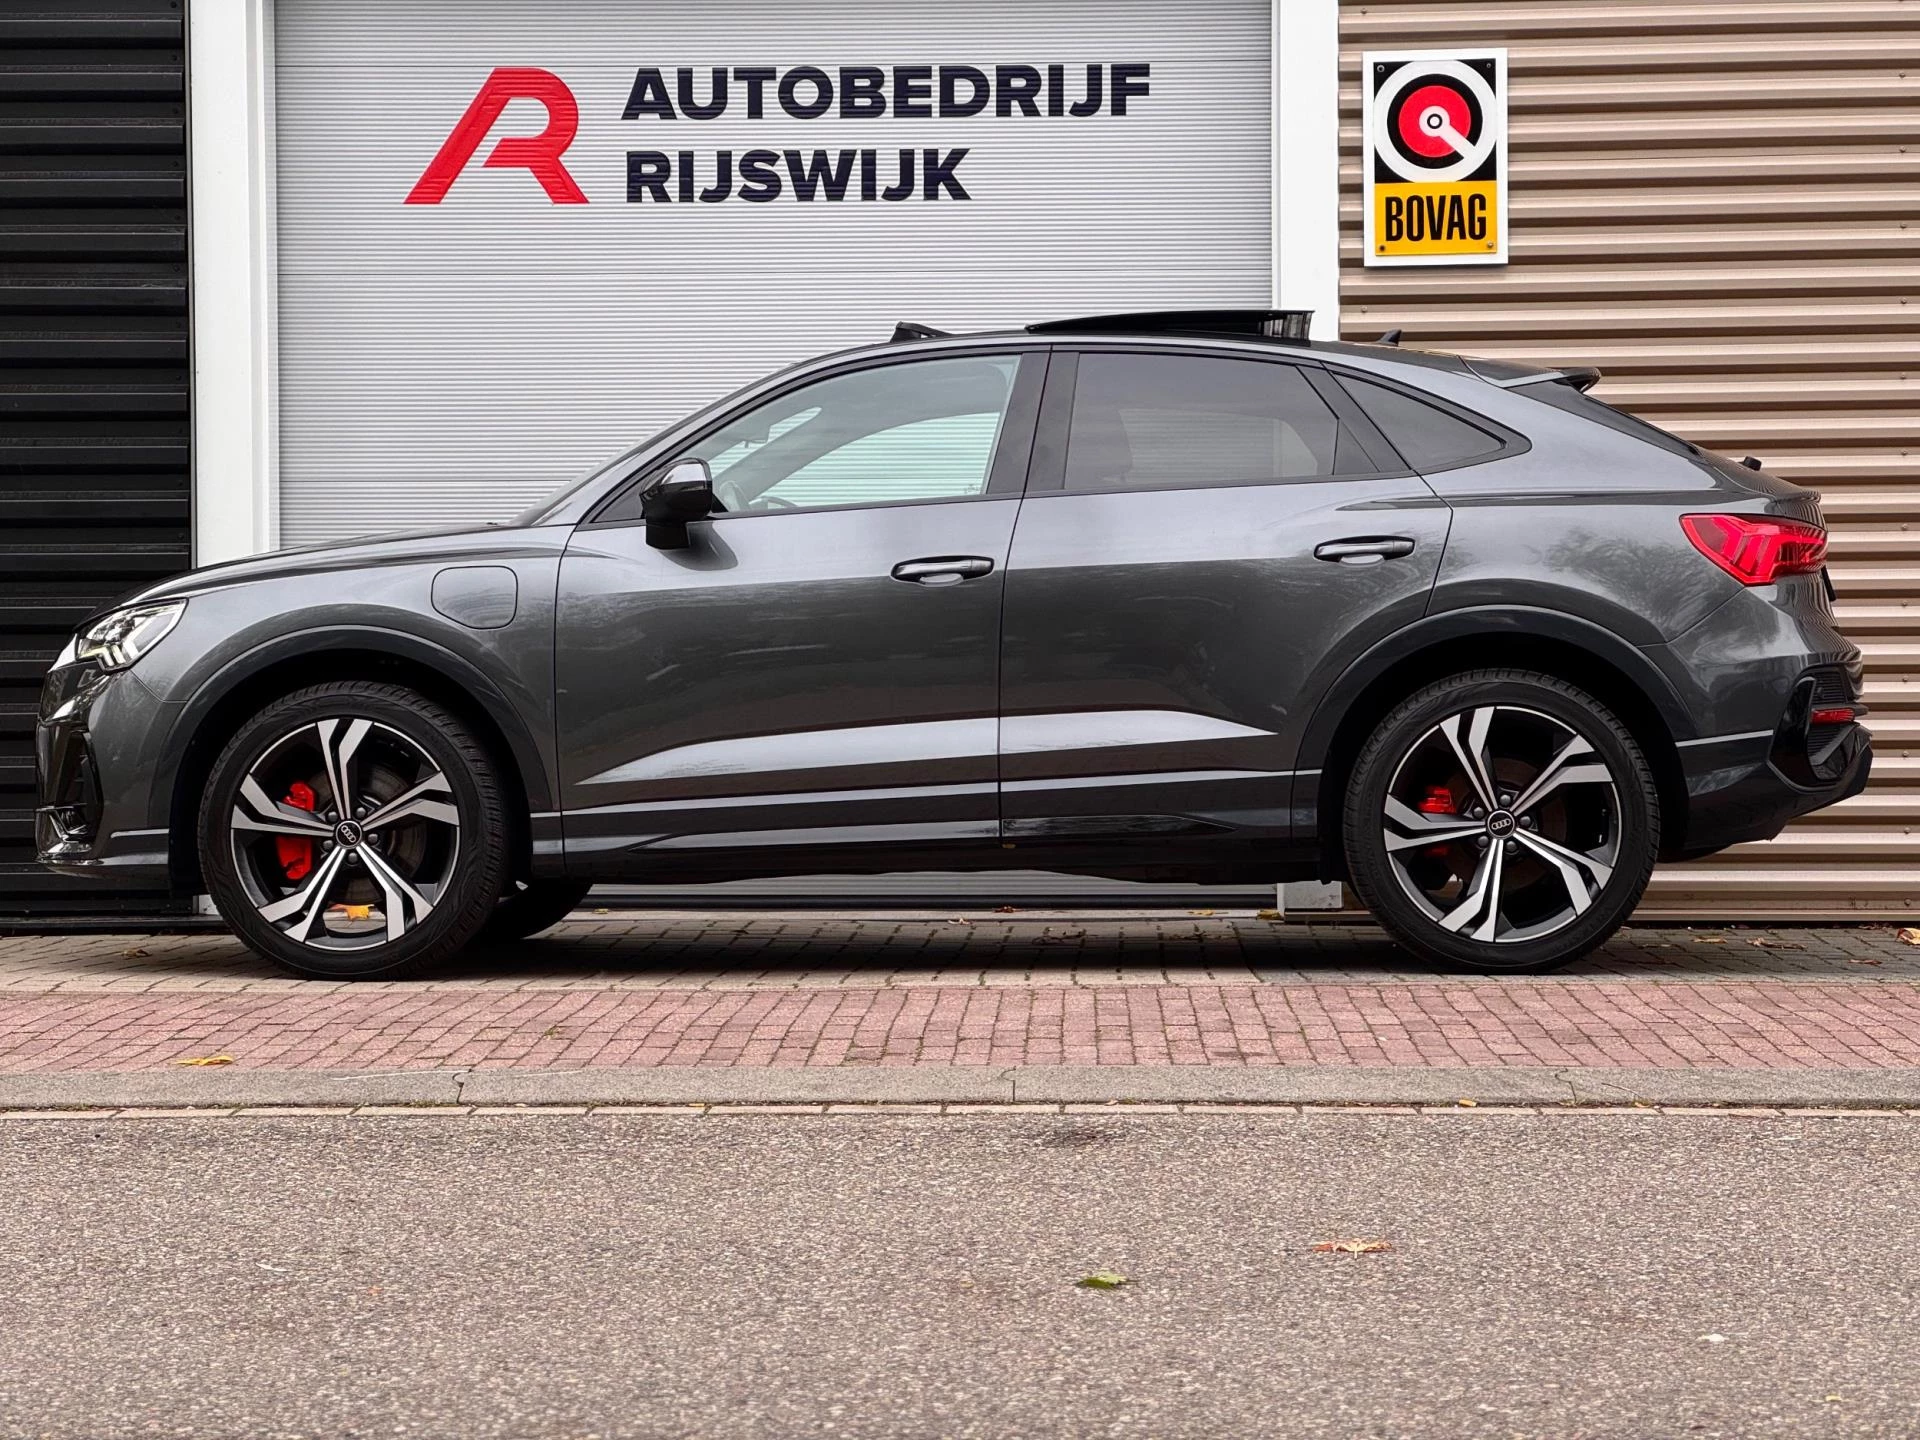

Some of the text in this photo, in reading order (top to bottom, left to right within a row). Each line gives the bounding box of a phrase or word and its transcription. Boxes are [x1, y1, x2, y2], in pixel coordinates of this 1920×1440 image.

[621, 63, 1151, 121] AUTOBEDRIJF
[626, 148, 972, 204] RIJSWIJK
[1385, 193, 1487, 242] BOVAG
